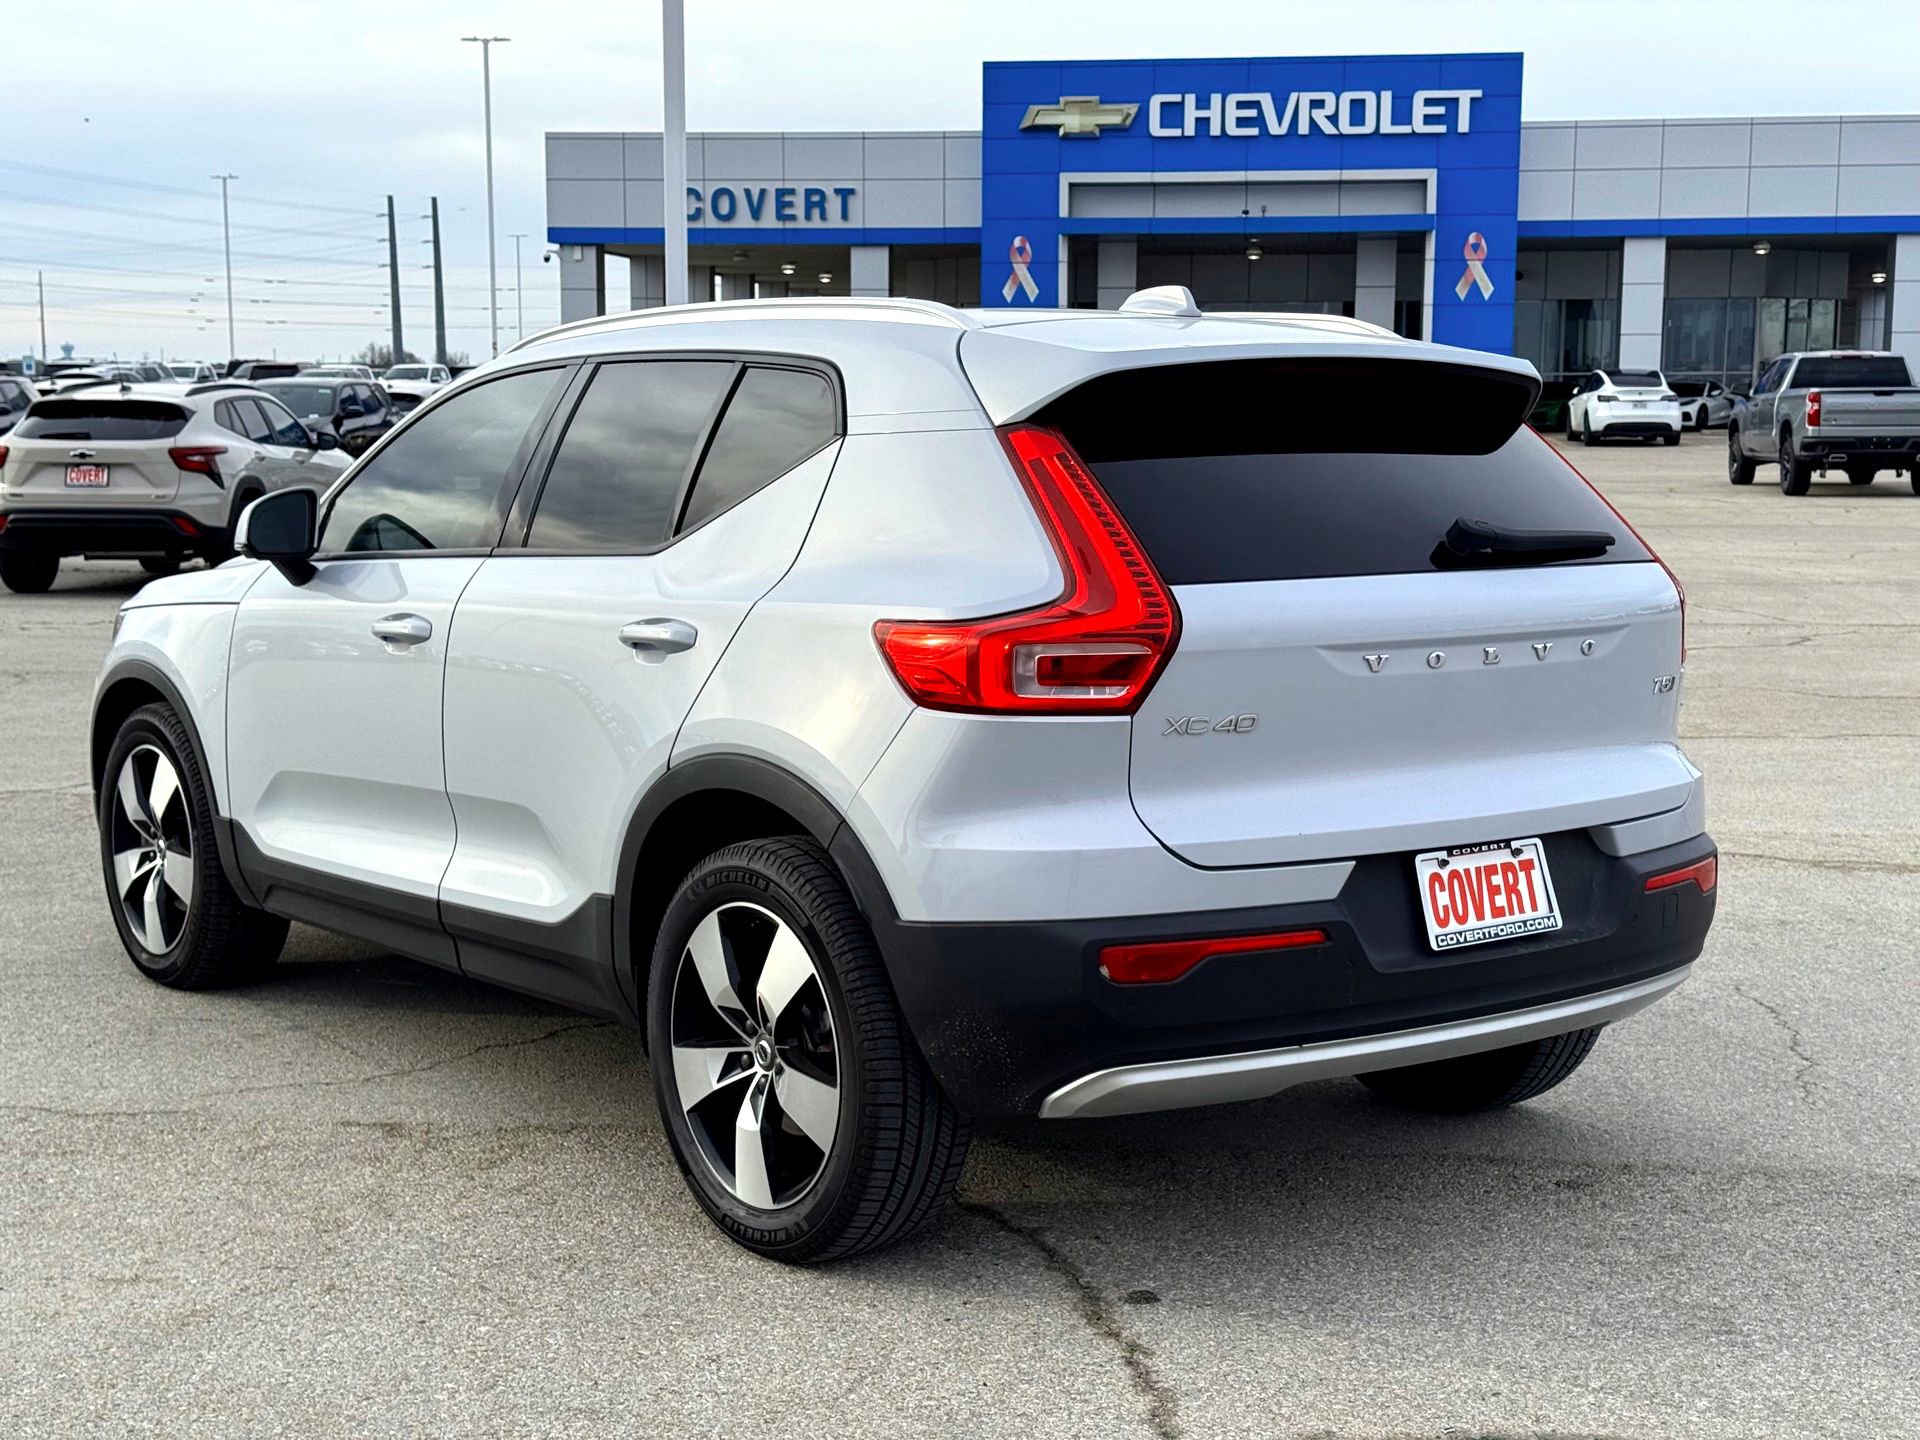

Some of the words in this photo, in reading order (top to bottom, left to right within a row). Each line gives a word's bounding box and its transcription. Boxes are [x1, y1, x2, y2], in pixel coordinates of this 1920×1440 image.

[1148, 89, 1483, 137] CHEVROLET
[686, 187, 856, 222] COVERT
[69, 467, 105, 483] COVERT
[1363, 639, 1596, 673] VOLVO
[1452, 843, 1506, 856] COVERT
[706, 871, 768, 890] MICHELIN
[1428, 858, 1539, 929] COVERT
[1437, 916, 1557, 947] COVERTFORD.COM
[723, 1216, 787, 1242] MICHELIN
